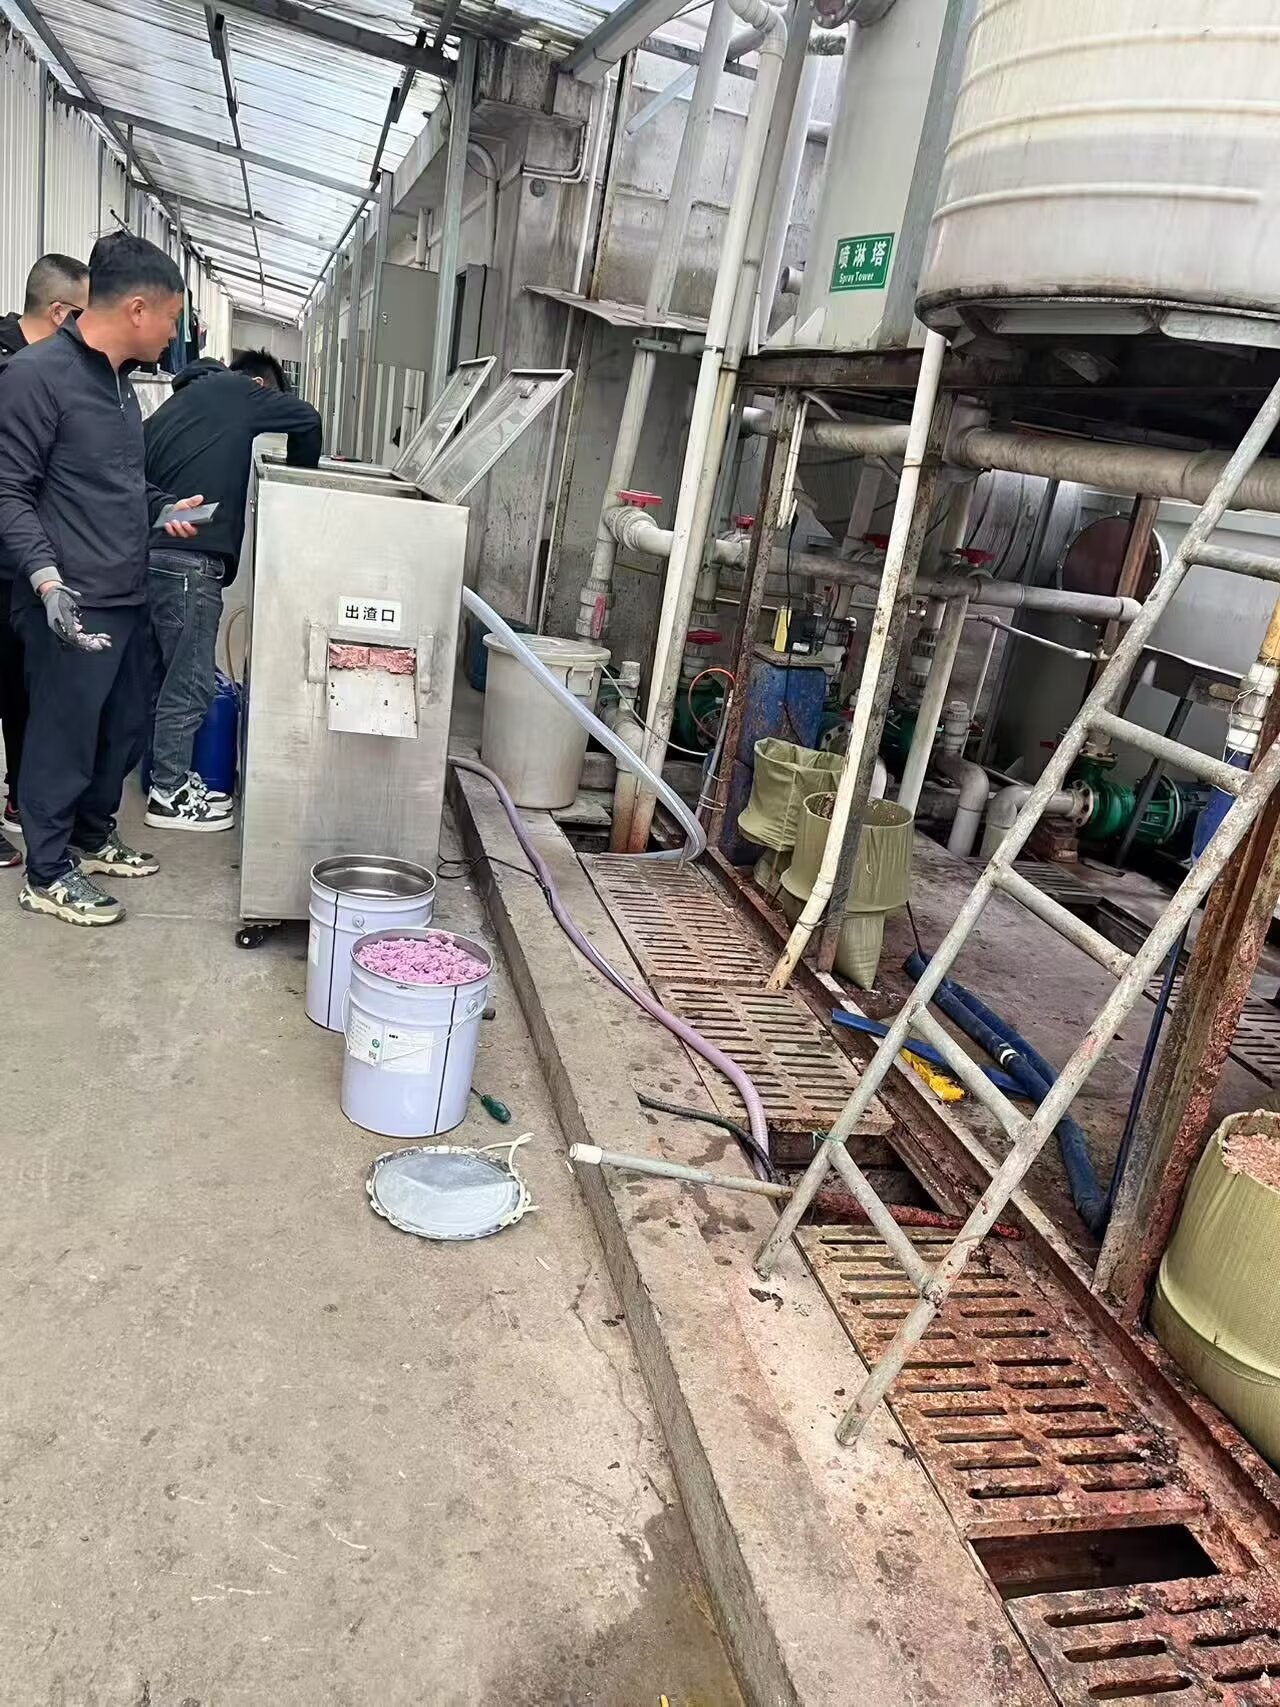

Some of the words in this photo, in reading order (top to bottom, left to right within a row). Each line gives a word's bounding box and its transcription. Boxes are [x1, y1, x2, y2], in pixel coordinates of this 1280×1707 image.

[838, 240, 887, 269] 喷淋塔
[839, 273, 854, 284] Spray
[855, 271, 874, 282] Tower
[345, 604, 395, 623] 出渣口
